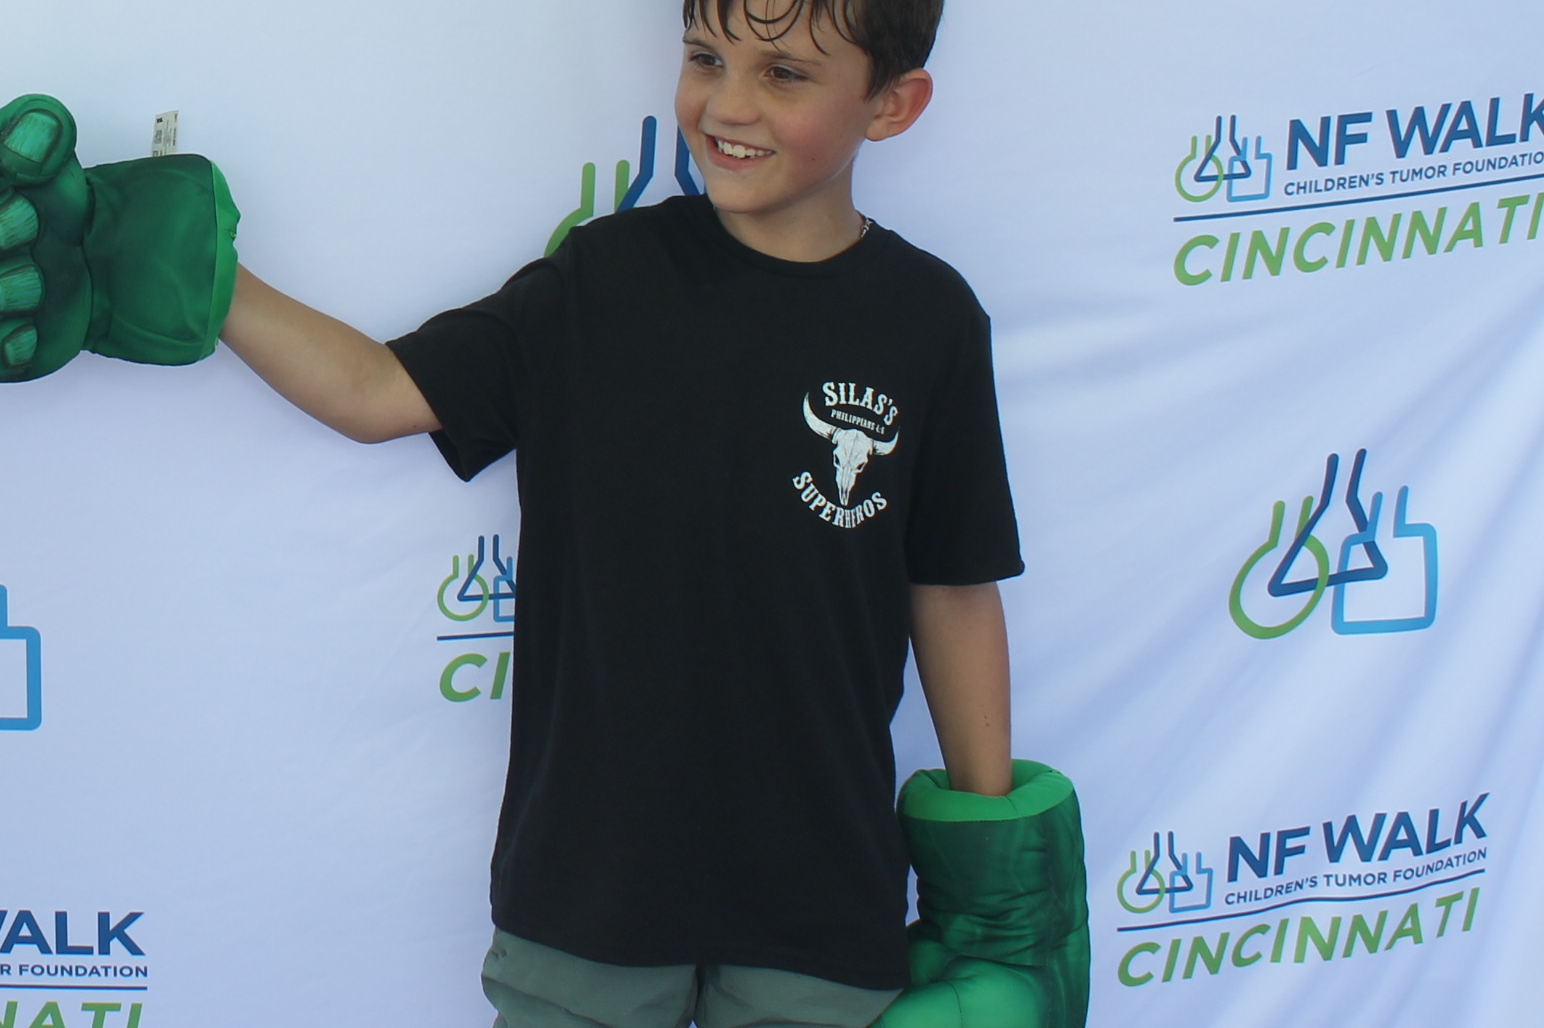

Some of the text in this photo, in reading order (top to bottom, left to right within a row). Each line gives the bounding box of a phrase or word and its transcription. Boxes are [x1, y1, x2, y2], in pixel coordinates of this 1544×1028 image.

[1287, 111, 1373, 171] NF
[1284, 174, 1384, 197] CHILDREN'S
[1389, 164, 1447, 184] TUMOR
[822, 381, 898, 425] SILAS'S
[1227, 792, 1490, 882] NF WALK
[1224, 847, 1487, 905] CHILDREN'S TUMOR FOUNDATION
[1117, 887, 1480, 987] CINCINNATI
[18, 963, 148, 978] FOUNDATION
